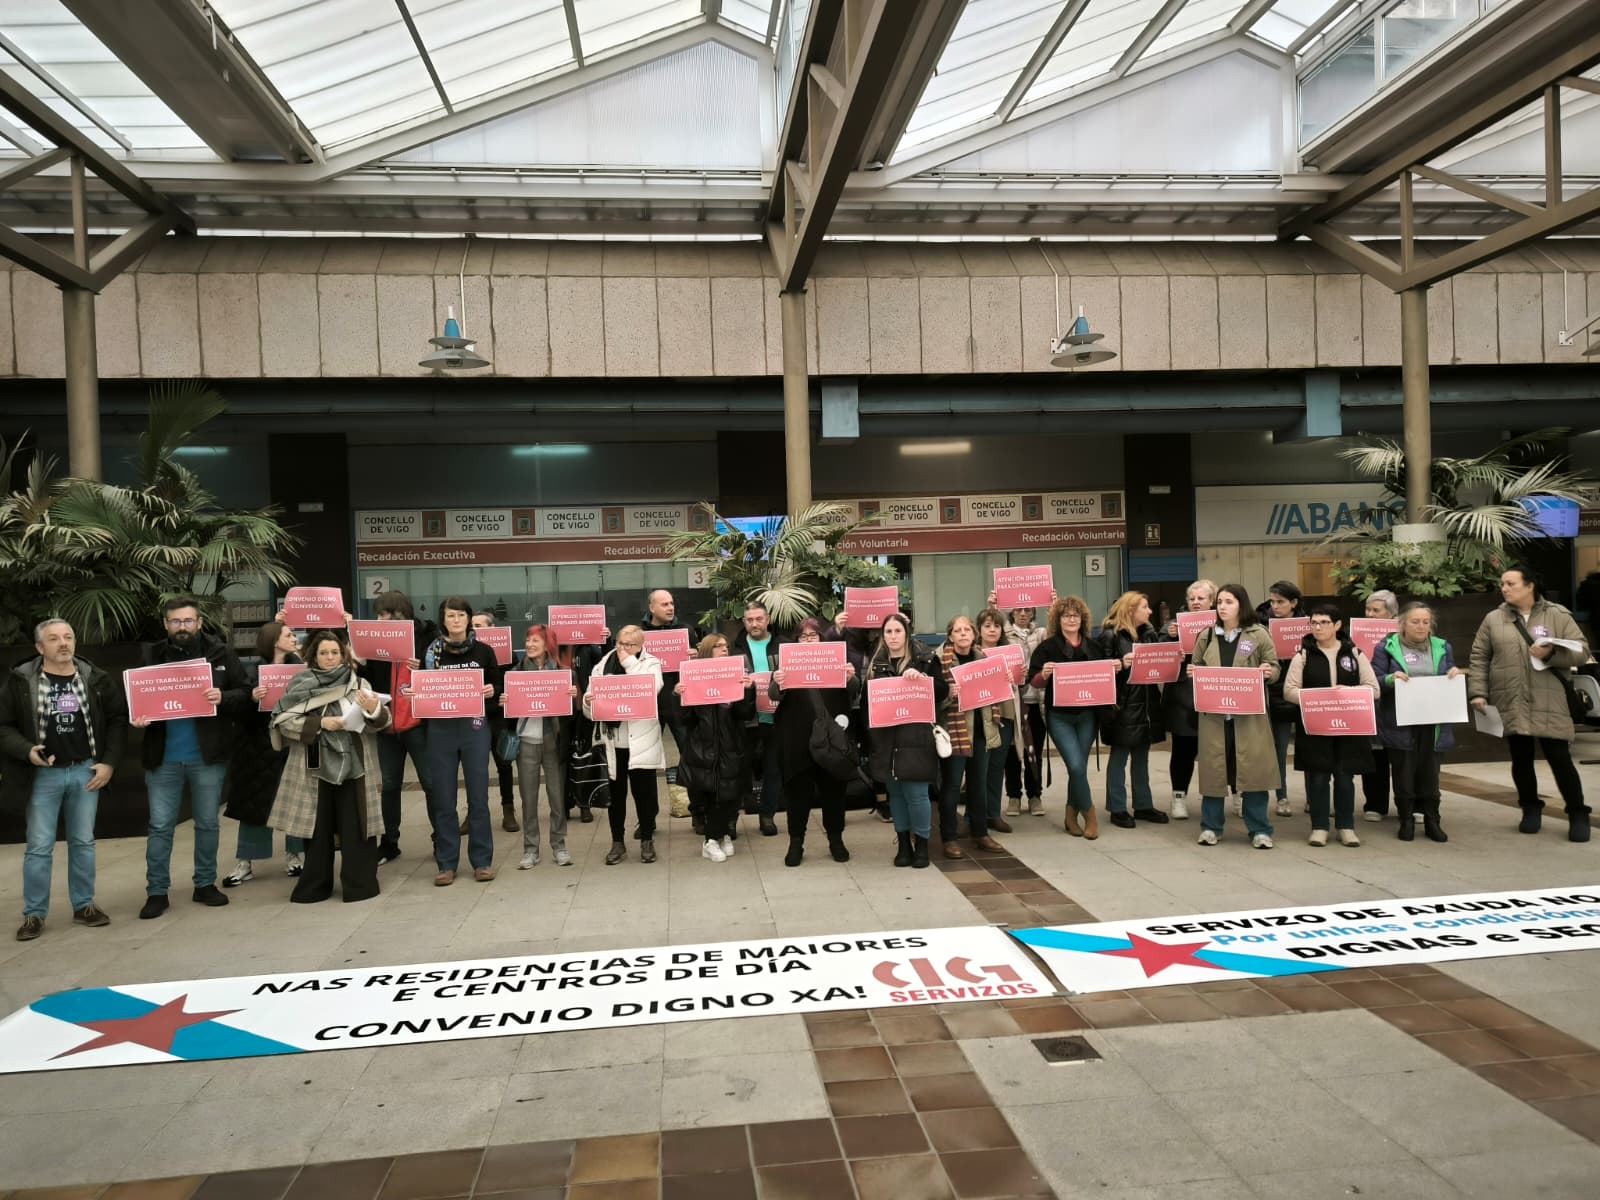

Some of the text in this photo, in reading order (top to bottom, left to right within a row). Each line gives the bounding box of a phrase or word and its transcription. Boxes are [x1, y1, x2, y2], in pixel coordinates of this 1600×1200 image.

[888, 503, 933, 513] CONCELLO
[971, 501, 1016, 510] CONCELLO
[1051, 498, 1095, 507] CONCELLO
[633, 511, 681, 519] CONCELLO
[977, 509, 1011, 518] DE VIGO
[1056, 506, 1090, 515] DE VIGO
[364, 516, 415, 525] CONCELLO
[455, 515, 505, 523] CONCELLO
[547, 512, 595, 521] CONCELLO
[894, 512, 928, 521] DE VIGO
[461, 523, 500, 532] DE VIGO
[553, 521, 589, 530] DE VIGO
[639, 519, 675, 528] DE VIGO
[370, 525, 409, 534] DE VIGO
[1022, 530, 1125, 542] Recadación Voluntaria
[859, 538, 909, 549] Voluntaria
[358, 550, 476, 562] Recadación Executiva
[604, 545, 661, 556] Recadación
[1091, 558, 1099, 571] 5
[694, 571, 703, 584] 3
[373, 581, 383, 595] 2
[1146, 914, 1327, 935] SERVIZO
[1333, 908, 1395, 920] DE
[1402, 898, 1541, 915] AXUDA
[1210, 932, 1278, 945] Por
[1288, 922, 1408, 940] unhas
[1286, 934, 1478, 959] DIGNAS
[1486, 933, 1519, 942] e
[252, 937, 928, 995] NAS RESIDENCIAS DE MAIORES
[872, 956, 1023, 988] CIG
[392, 958, 812, 1002] E CENTROS DE DÍA
[889, 983, 1038, 1003] SERVIZOS
[315, 985, 868, 1041] CONVENIO DIGNO XA!
